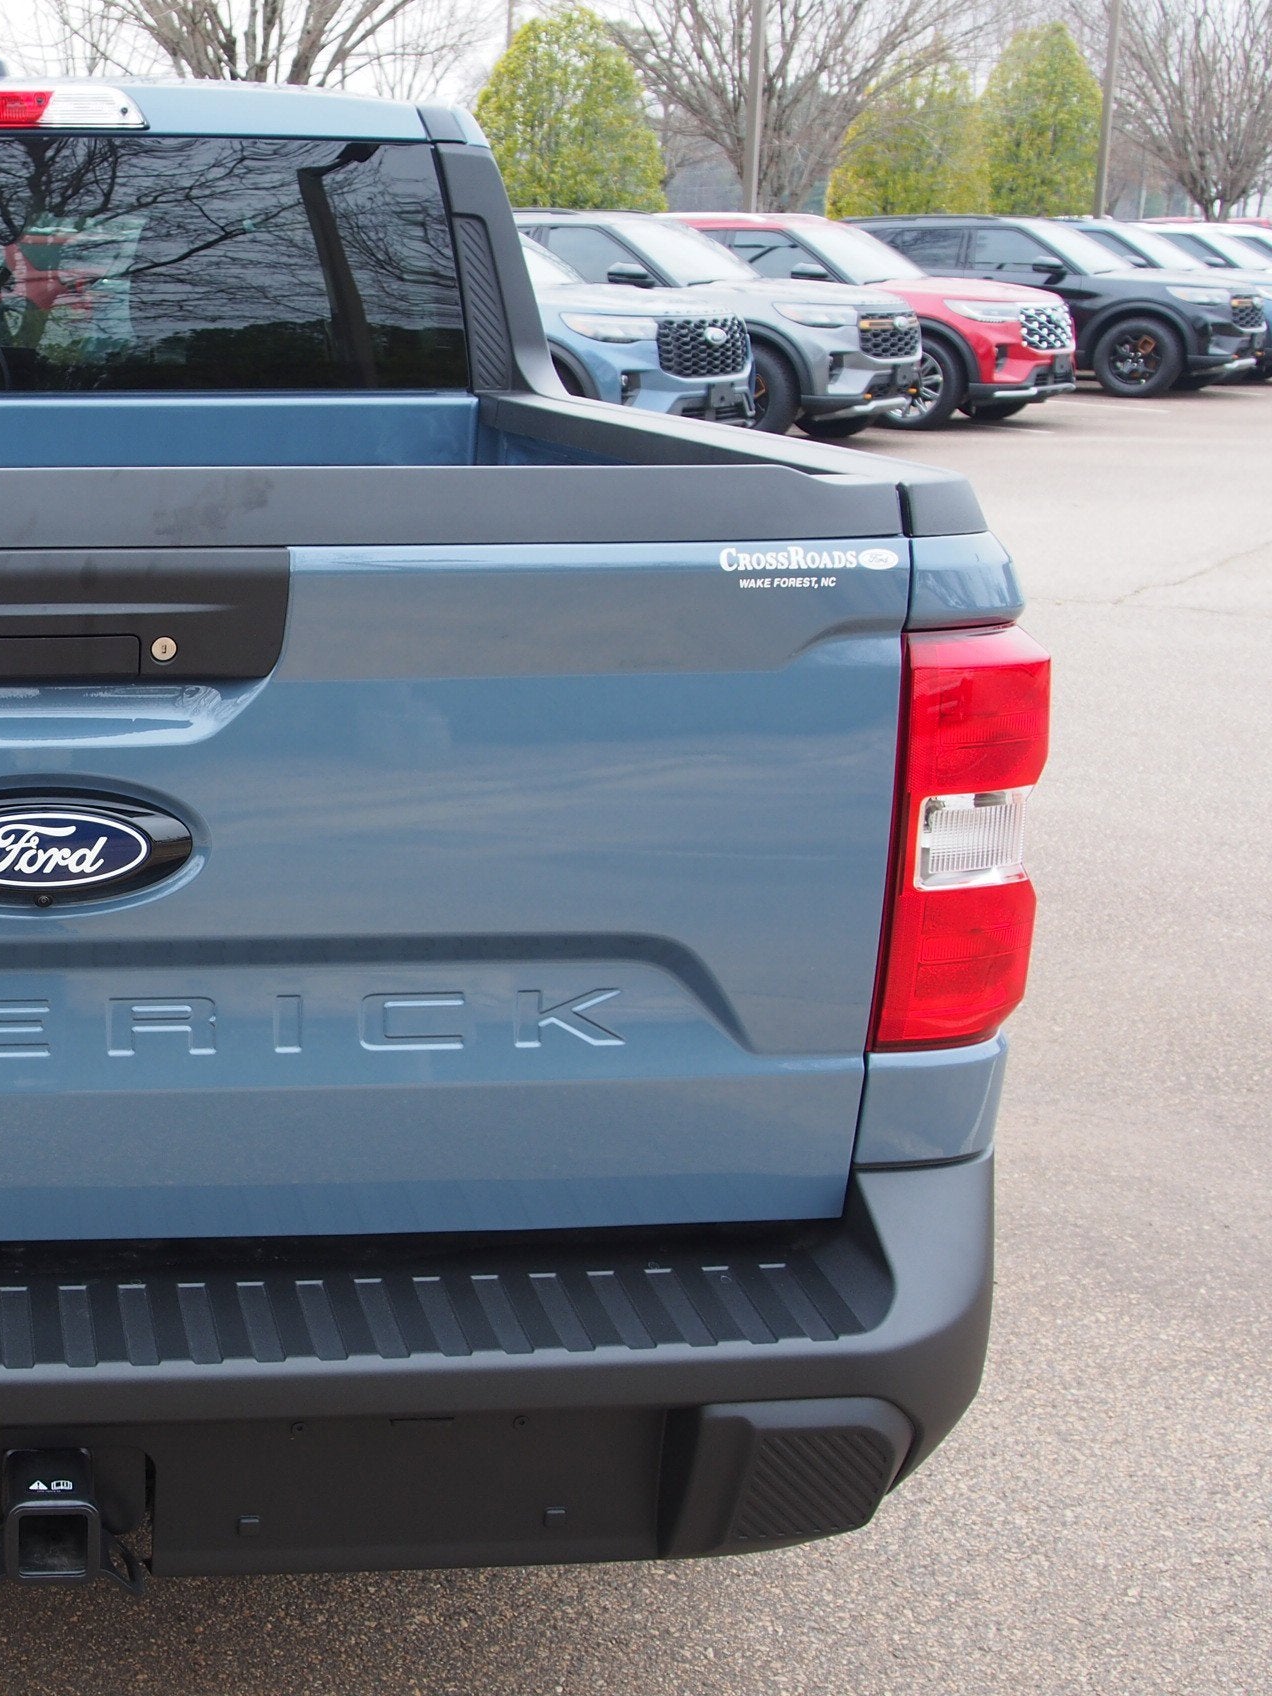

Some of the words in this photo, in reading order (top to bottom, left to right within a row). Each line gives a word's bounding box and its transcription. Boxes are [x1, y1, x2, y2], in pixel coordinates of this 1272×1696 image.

[739, 577, 771, 589] WAKE
[773, 576, 818, 589] FOREST,
[820, 576, 837, 588] NC
